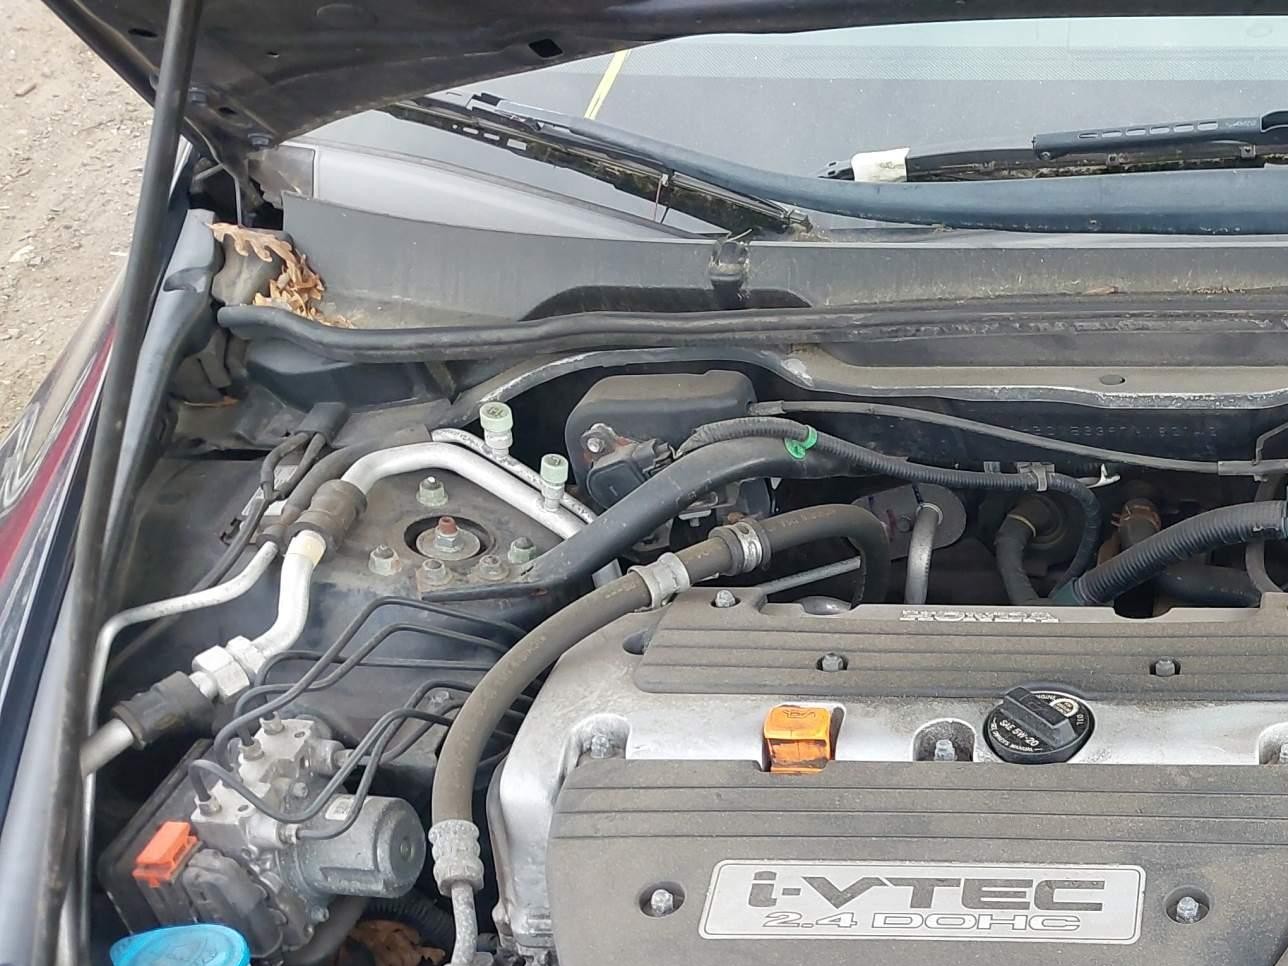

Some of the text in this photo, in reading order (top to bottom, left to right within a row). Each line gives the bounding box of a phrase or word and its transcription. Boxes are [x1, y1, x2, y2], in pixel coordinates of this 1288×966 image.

[1000, 719, 1040, 747] SAE 5W-20
[748, 870, 1106, 912] i-VTEC
[762, 911, 1081, 932] 2.4 DOHC
